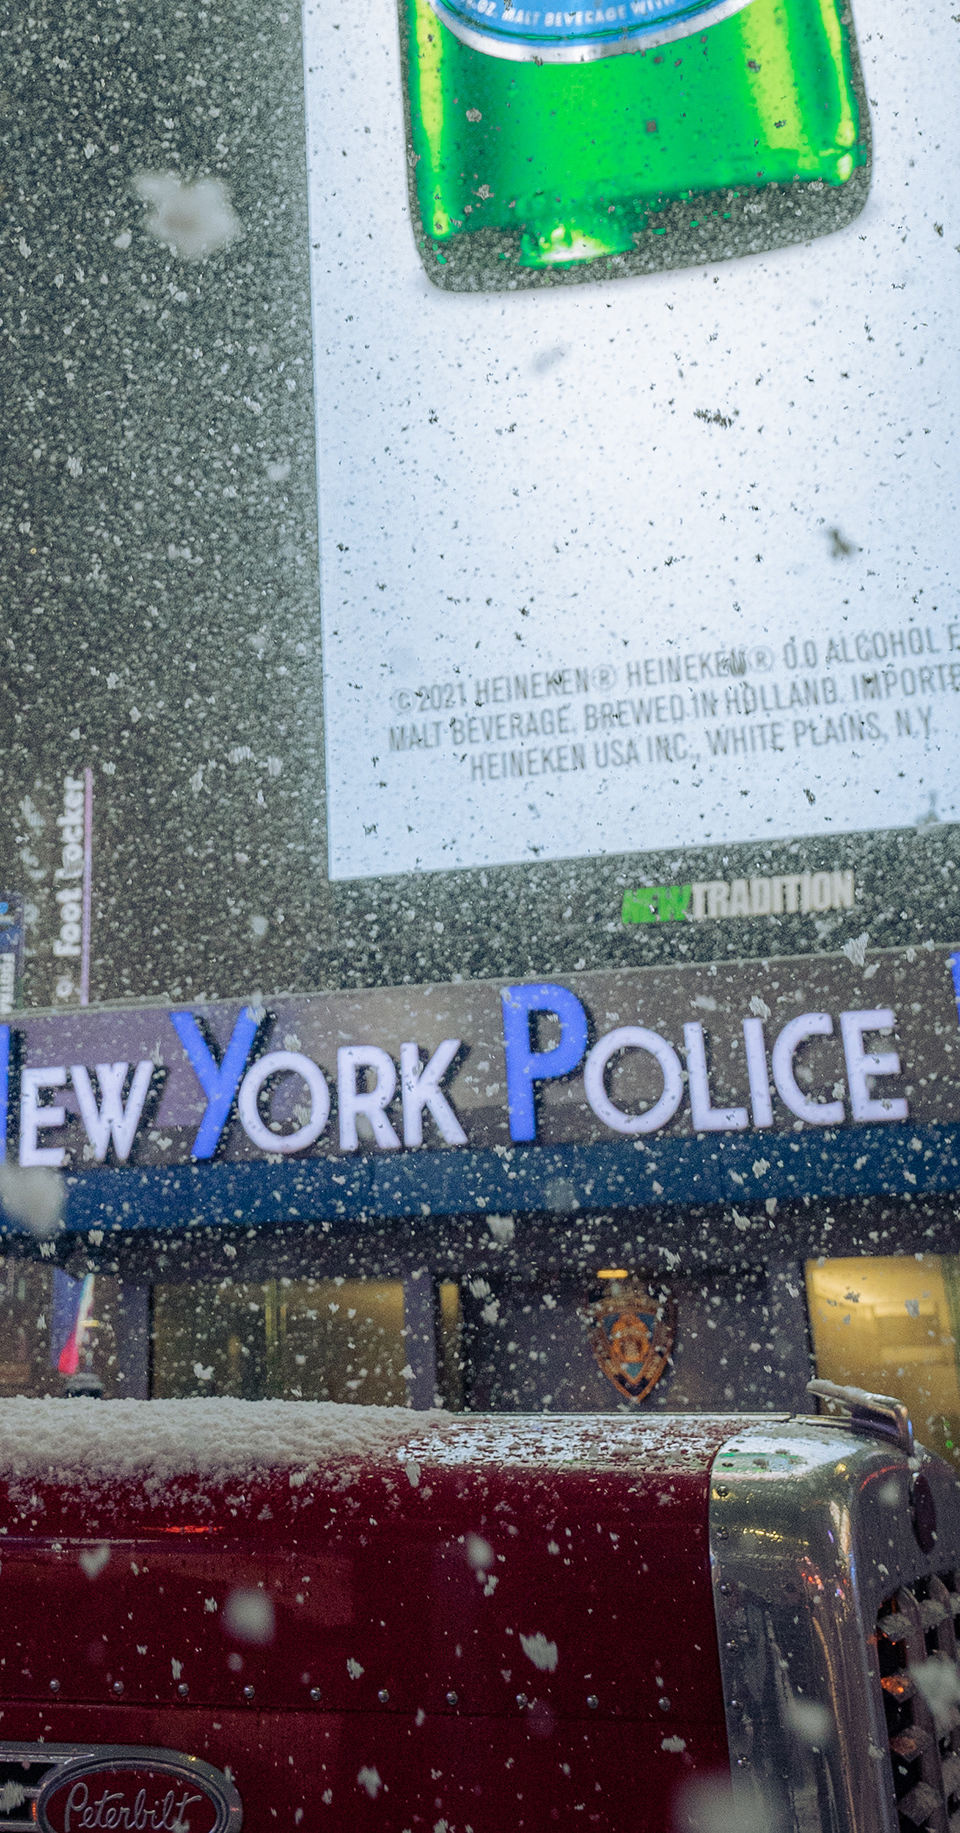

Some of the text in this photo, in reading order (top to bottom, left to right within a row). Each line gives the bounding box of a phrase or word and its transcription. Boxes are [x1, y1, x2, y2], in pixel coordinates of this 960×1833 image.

[825, 626, 941, 665] ALCOHOL
[390, 721, 442, 751] MALT
[584, 693, 685, 732] BREWED
[692, 690, 717, 718] IN
[851, 662, 960, 702] IMPORTE
[470, 742, 587, 781] HEINEKEN
[593, 738, 640, 768] USA
[704, 721, 782, 757] WHITE
[169, 1005, 469, 1162] YORK
[502, 982, 911, 1143] POLICE
[64, 1781, 203, 1833] Peterbilt
